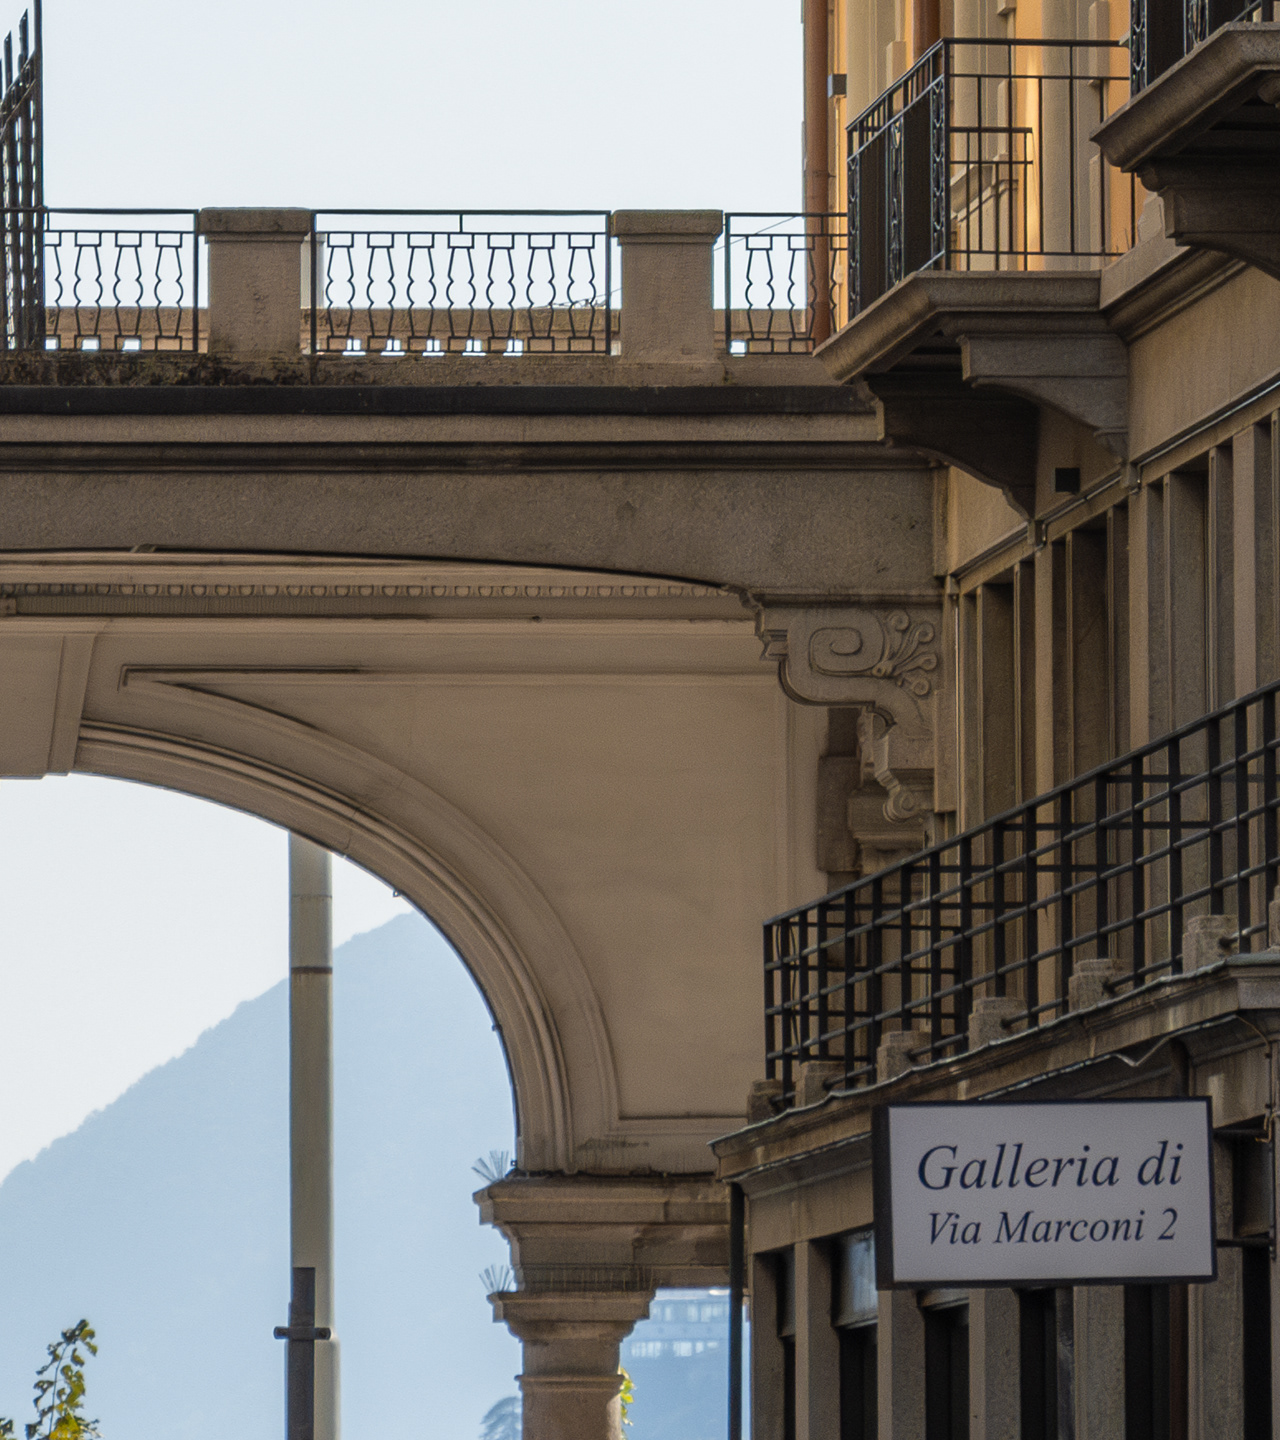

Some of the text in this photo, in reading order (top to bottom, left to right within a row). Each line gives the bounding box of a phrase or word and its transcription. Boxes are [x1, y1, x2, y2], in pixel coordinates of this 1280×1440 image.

[918, 1140, 1185, 1190] Galleria di
[929, 1208, 1179, 1245] Via Marconi 2
